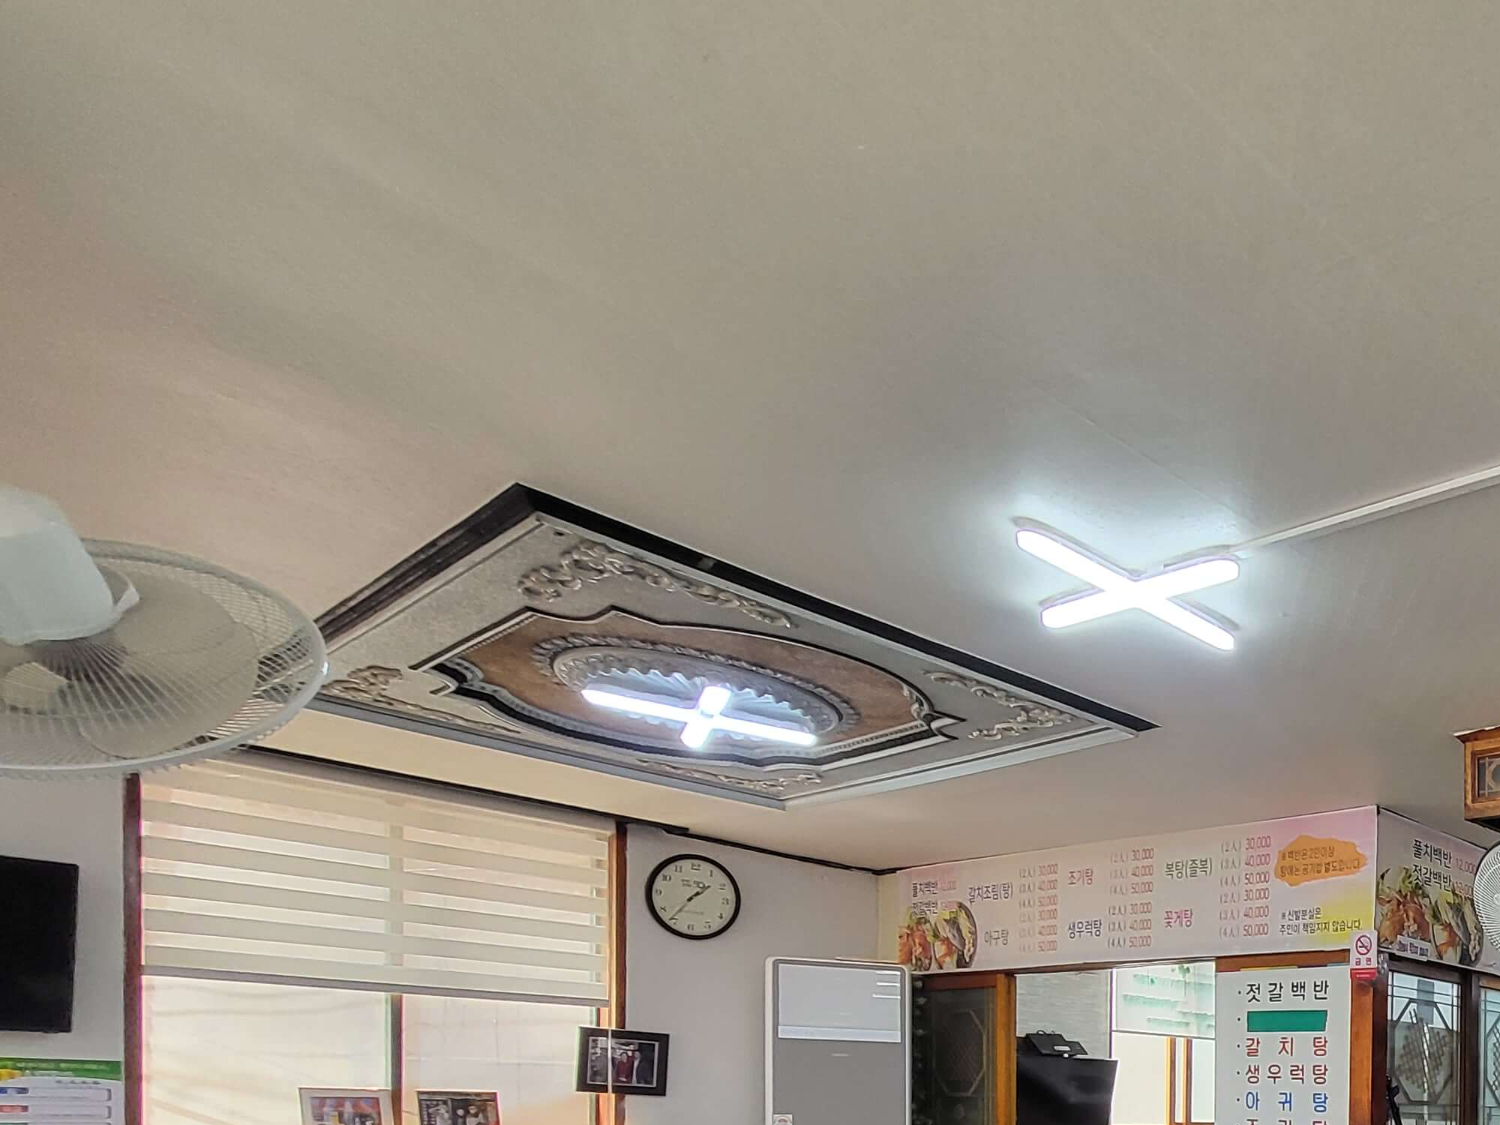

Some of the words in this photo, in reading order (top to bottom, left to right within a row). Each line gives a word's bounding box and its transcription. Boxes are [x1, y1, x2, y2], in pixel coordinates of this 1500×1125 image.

[1245, 835, 1271, 851] 30,000
[1165, 857, 1213, 880] 복탕(졸복)
[1244, 853, 1271, 867] 40,000
[1067, 868, 1094, 886] 조기탕
[1244, 871, 1270, 885] 50,000
[1412, 864, 1452, 892] 젓갈백반
[967, 882, 1013, 906] 갈치조림(탕)
[1243, 887, 1270, 902] 30,000
[1164, 908, 1193, 929] 꽃게탕
[1243, 905, 1269, 920] 40,000
[1067, 919, 1102, 939] 생우럭탕
[1242, 923, 1269, 937] 50,000
